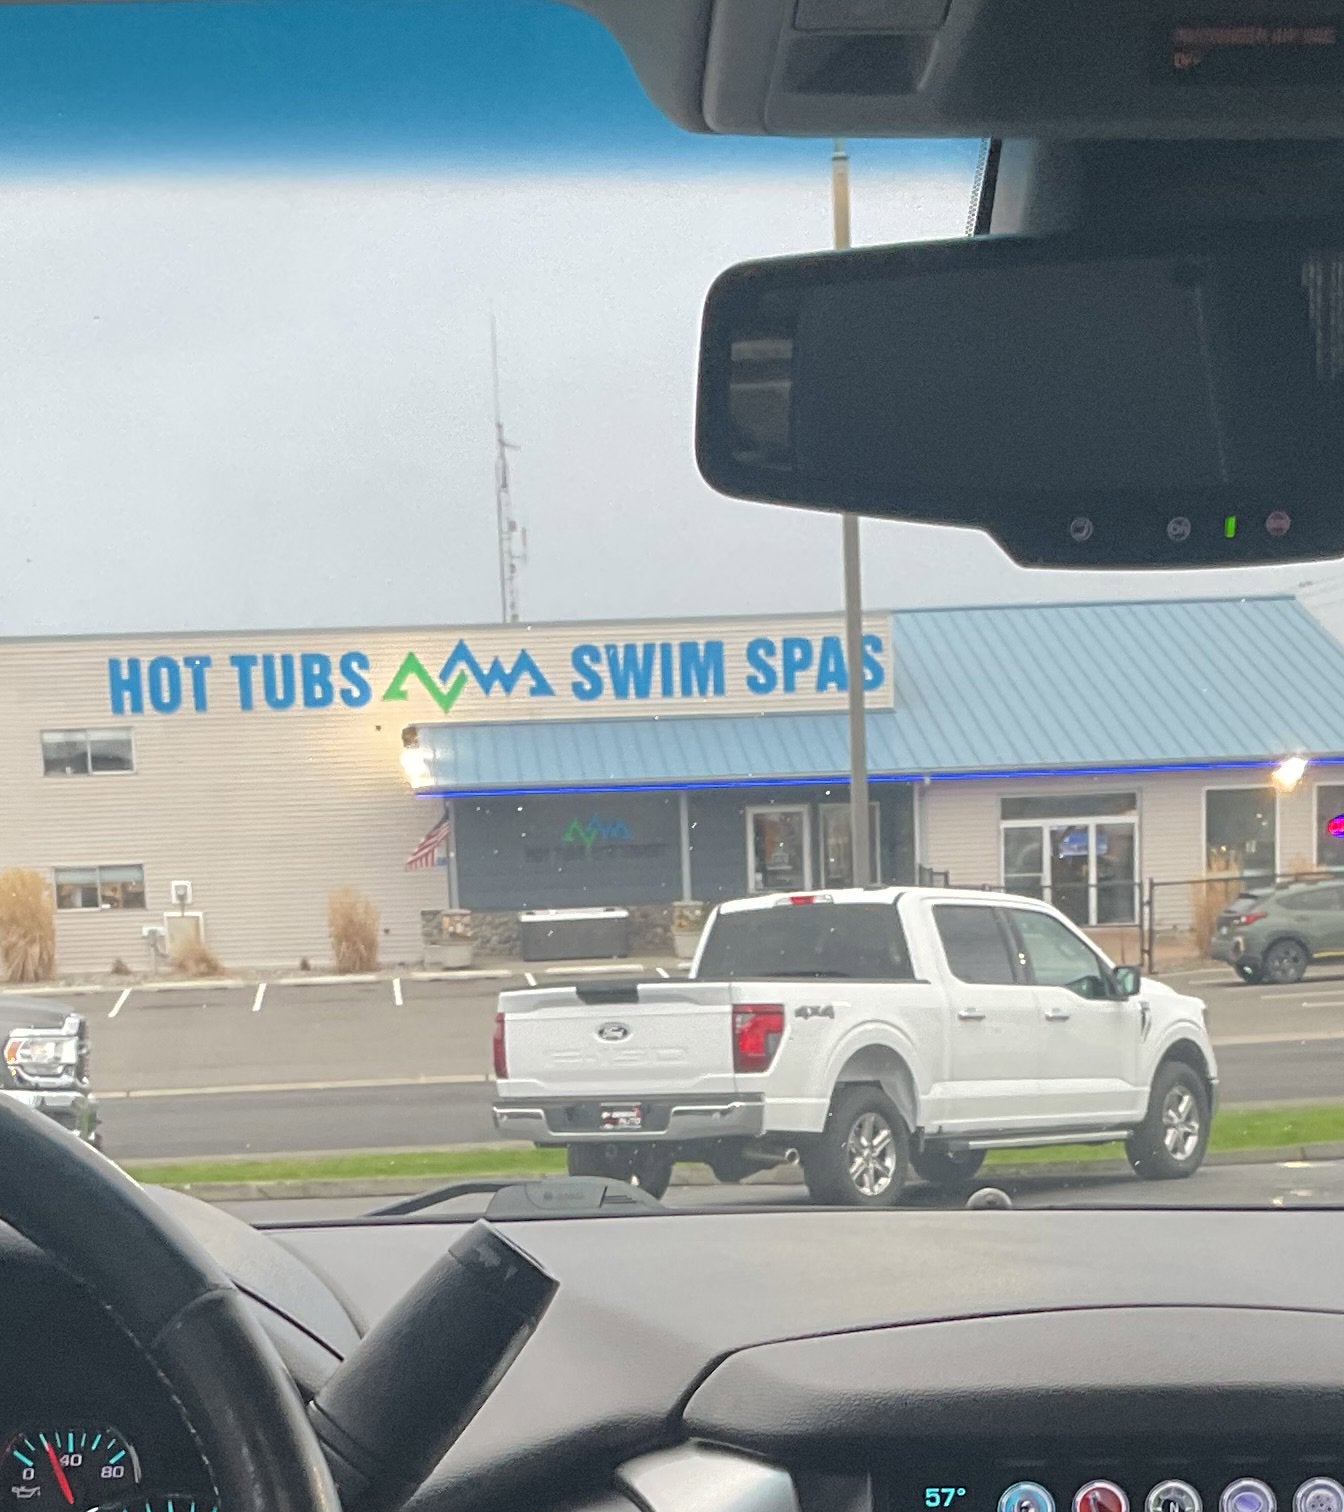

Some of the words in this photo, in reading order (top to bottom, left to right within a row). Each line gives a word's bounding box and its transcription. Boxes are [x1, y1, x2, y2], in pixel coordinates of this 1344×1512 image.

[108, 655, 212, 714] HOT
[229, 651, 372, 711] TUBS
[570, 640, 726, 700] SWIM
[746, 634, 885, 695] SPAS
[59, 1453, 82, 1467] 40
[100, 1465, 124, 1479] 80
